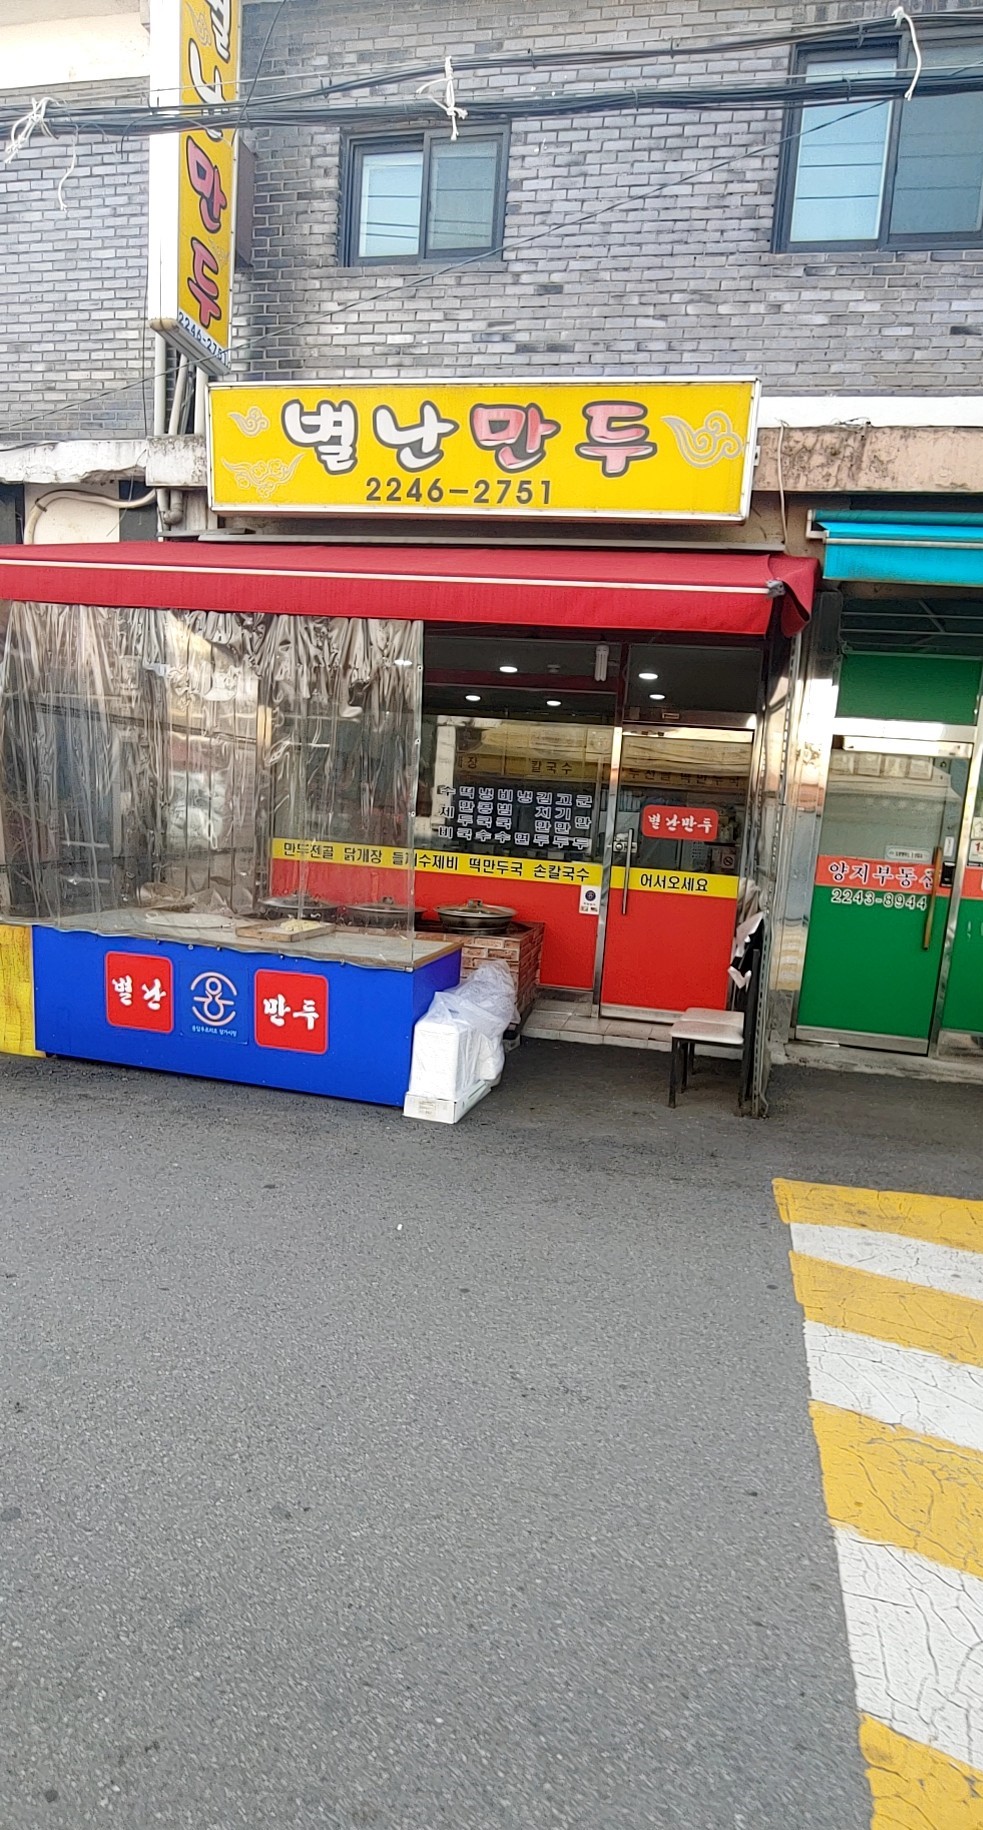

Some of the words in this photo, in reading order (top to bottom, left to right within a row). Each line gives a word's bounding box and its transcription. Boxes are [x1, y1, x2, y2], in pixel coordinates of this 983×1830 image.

[281, 399, 657, 477] 별난만두
[365, 477, 552, 505] 2246-2751
[531, 760, 573, 775] 칼국수
[438, 785, 456, 839] 수제비
[456, 786, 475, 840] 떡만두국
[494, 788, 514, 844] 비빔국수
[514, 790, 533, 846] 냉면
[533, 791, 552, 847] 김치만두
[552, 792, 572, 848] 고기만두
[572, 795, 592, 850] 군만두
[647, 812, 713, 834] 별난만두
[283, 842, 334, 860] 만두전골
[344, 847, 382, 864] 닭개장
[469, 857, 524, 876] 떡만두국
[533, 863, 590, 882] 손칼국수
[640, 873, 708, 892] 어서오세요
[830, 888, 927, 911] 2243-8944
[111, 974, 167, 1011] 별난
[263, 994, 320, 1031] 만두
